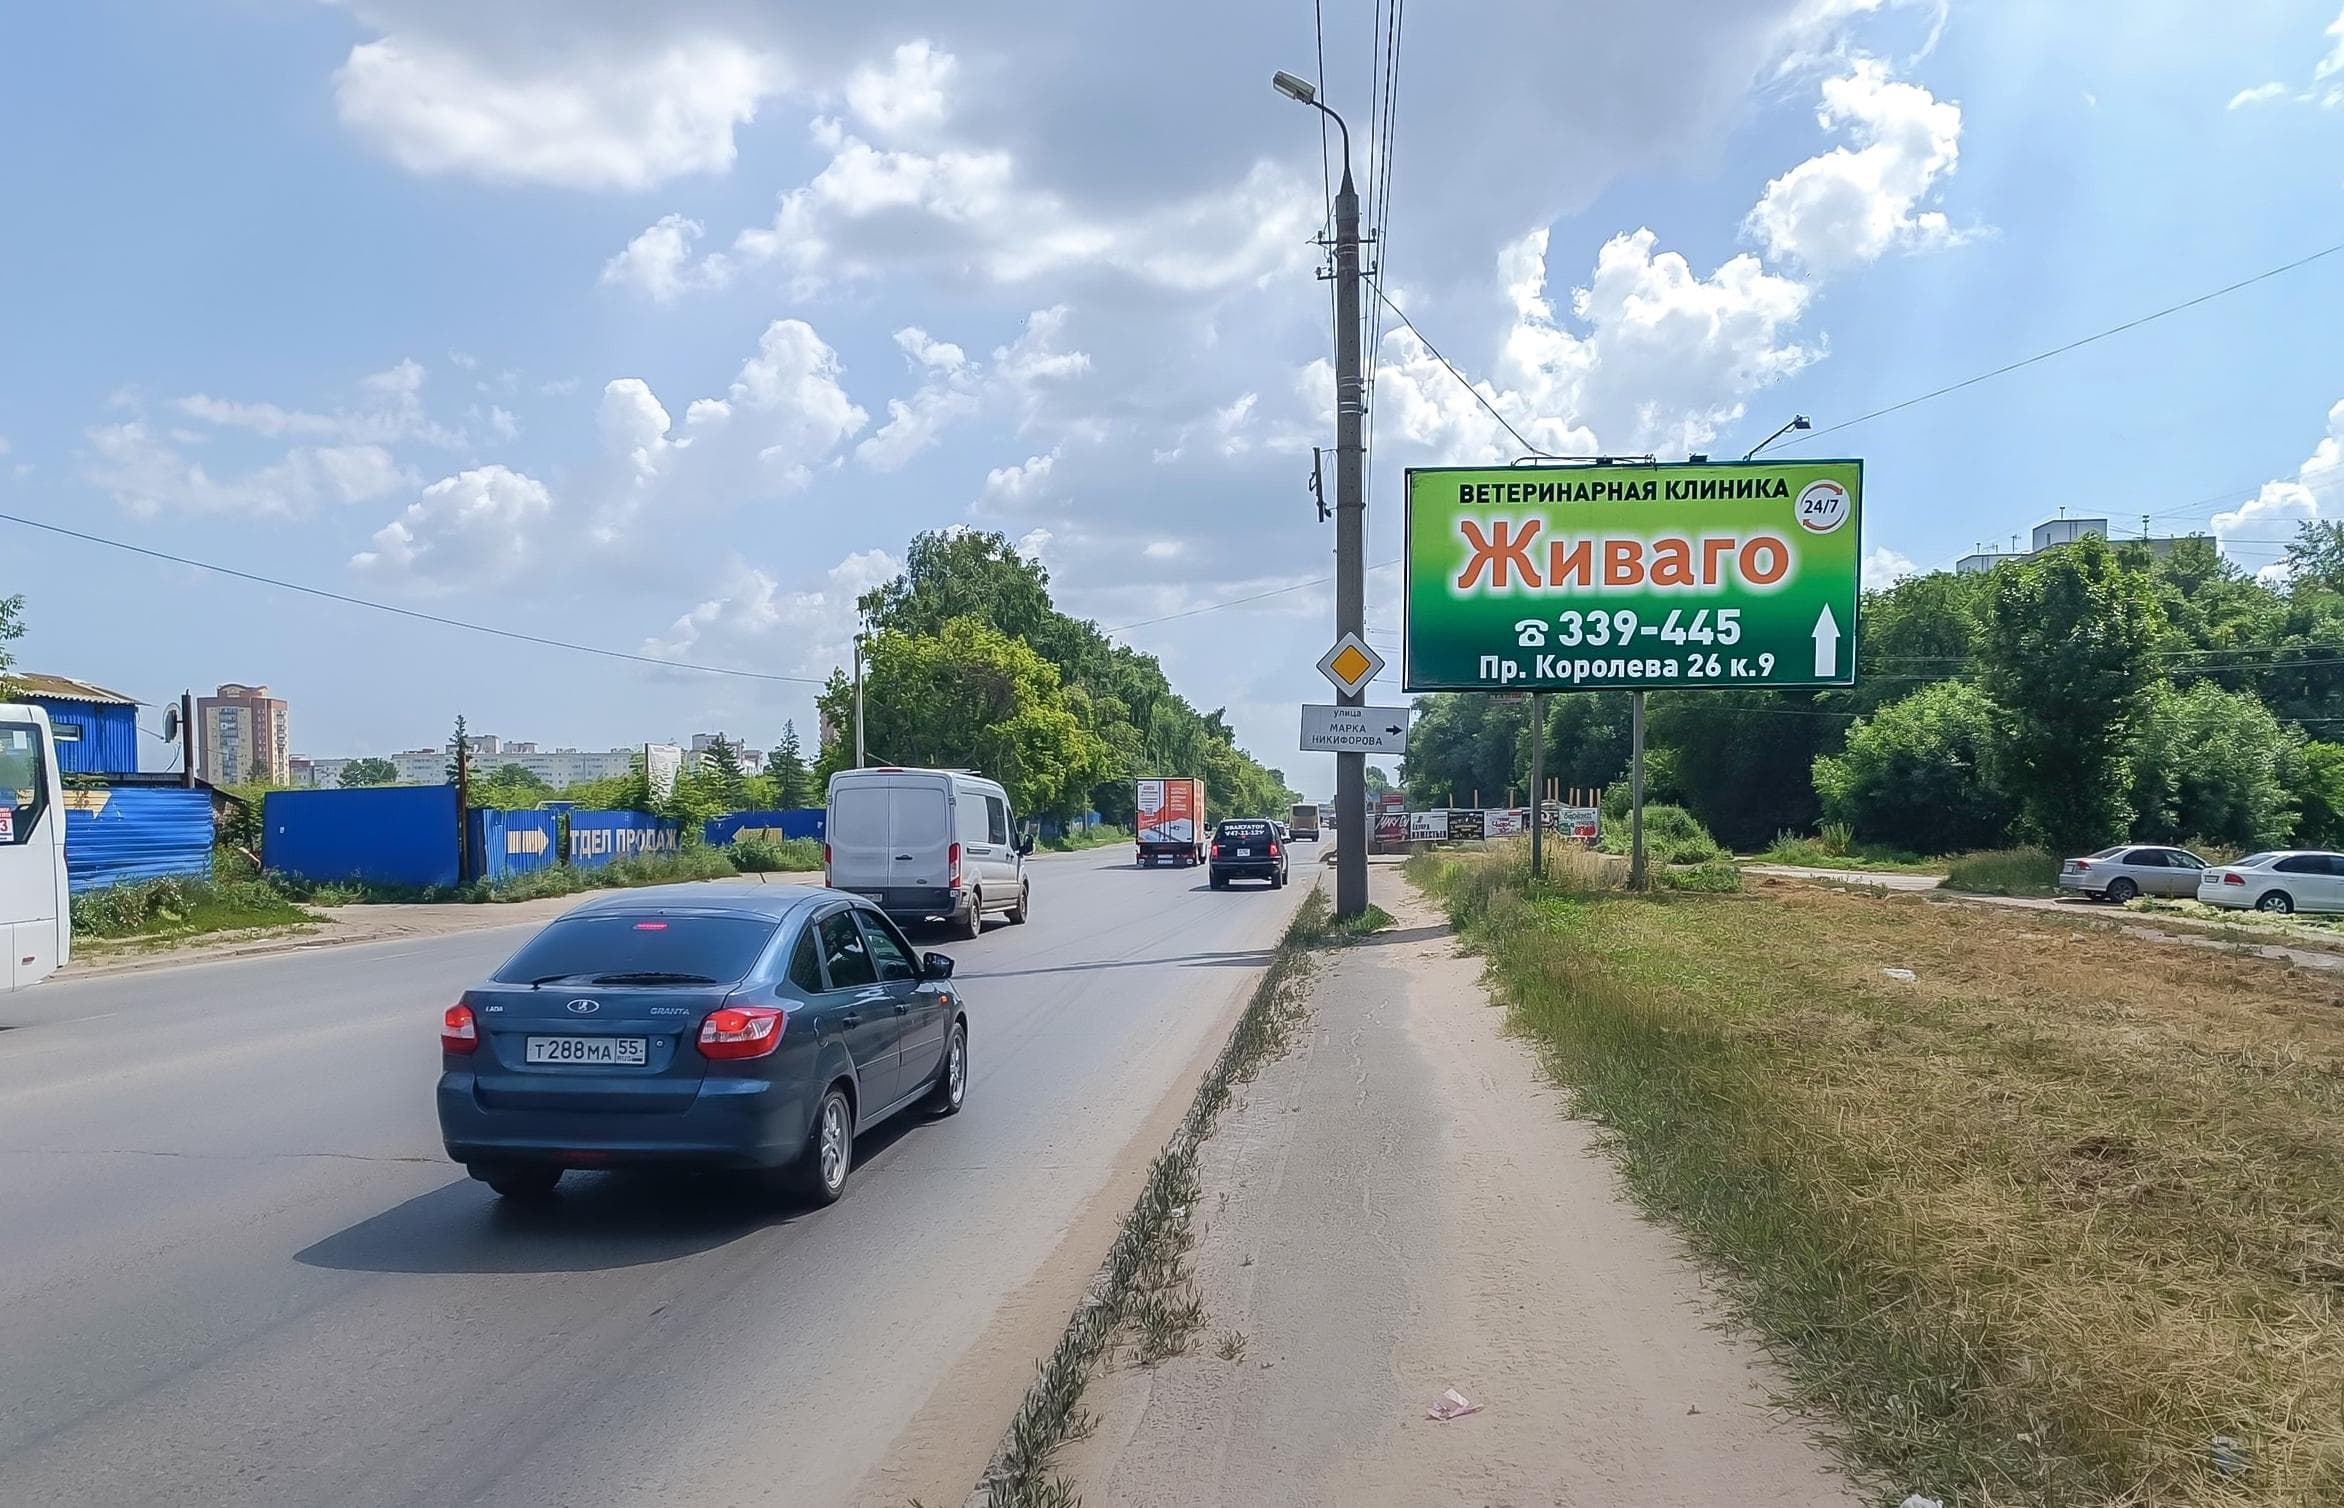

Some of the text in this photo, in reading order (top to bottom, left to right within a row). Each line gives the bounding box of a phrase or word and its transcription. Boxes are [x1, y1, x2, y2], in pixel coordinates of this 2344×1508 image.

[1459, 478, 1790, 504] ВЕТЕРИНАРНАЯ КЛИНИКА
[1803, 499, 1839, 514] 24/7
[1457, 519, 1790, 589] Живаго
[1558, 608, 1742, 647] 339-445
[1478, 652, 1776, 682] Пр. Королева 26 к.9
[1333, 710, 1362, 718] улица
[1329, 723, 1367, 733] МАРКА
[1312, 734, 1383, 746] НИКИФОРОВА
[570, 828, 677, 859] ТДЕЛ ПРОДАЖ
[650, 1007, 690, 1015] GRANTA
[535, 1040, 638, 1061] Т288МА 55
